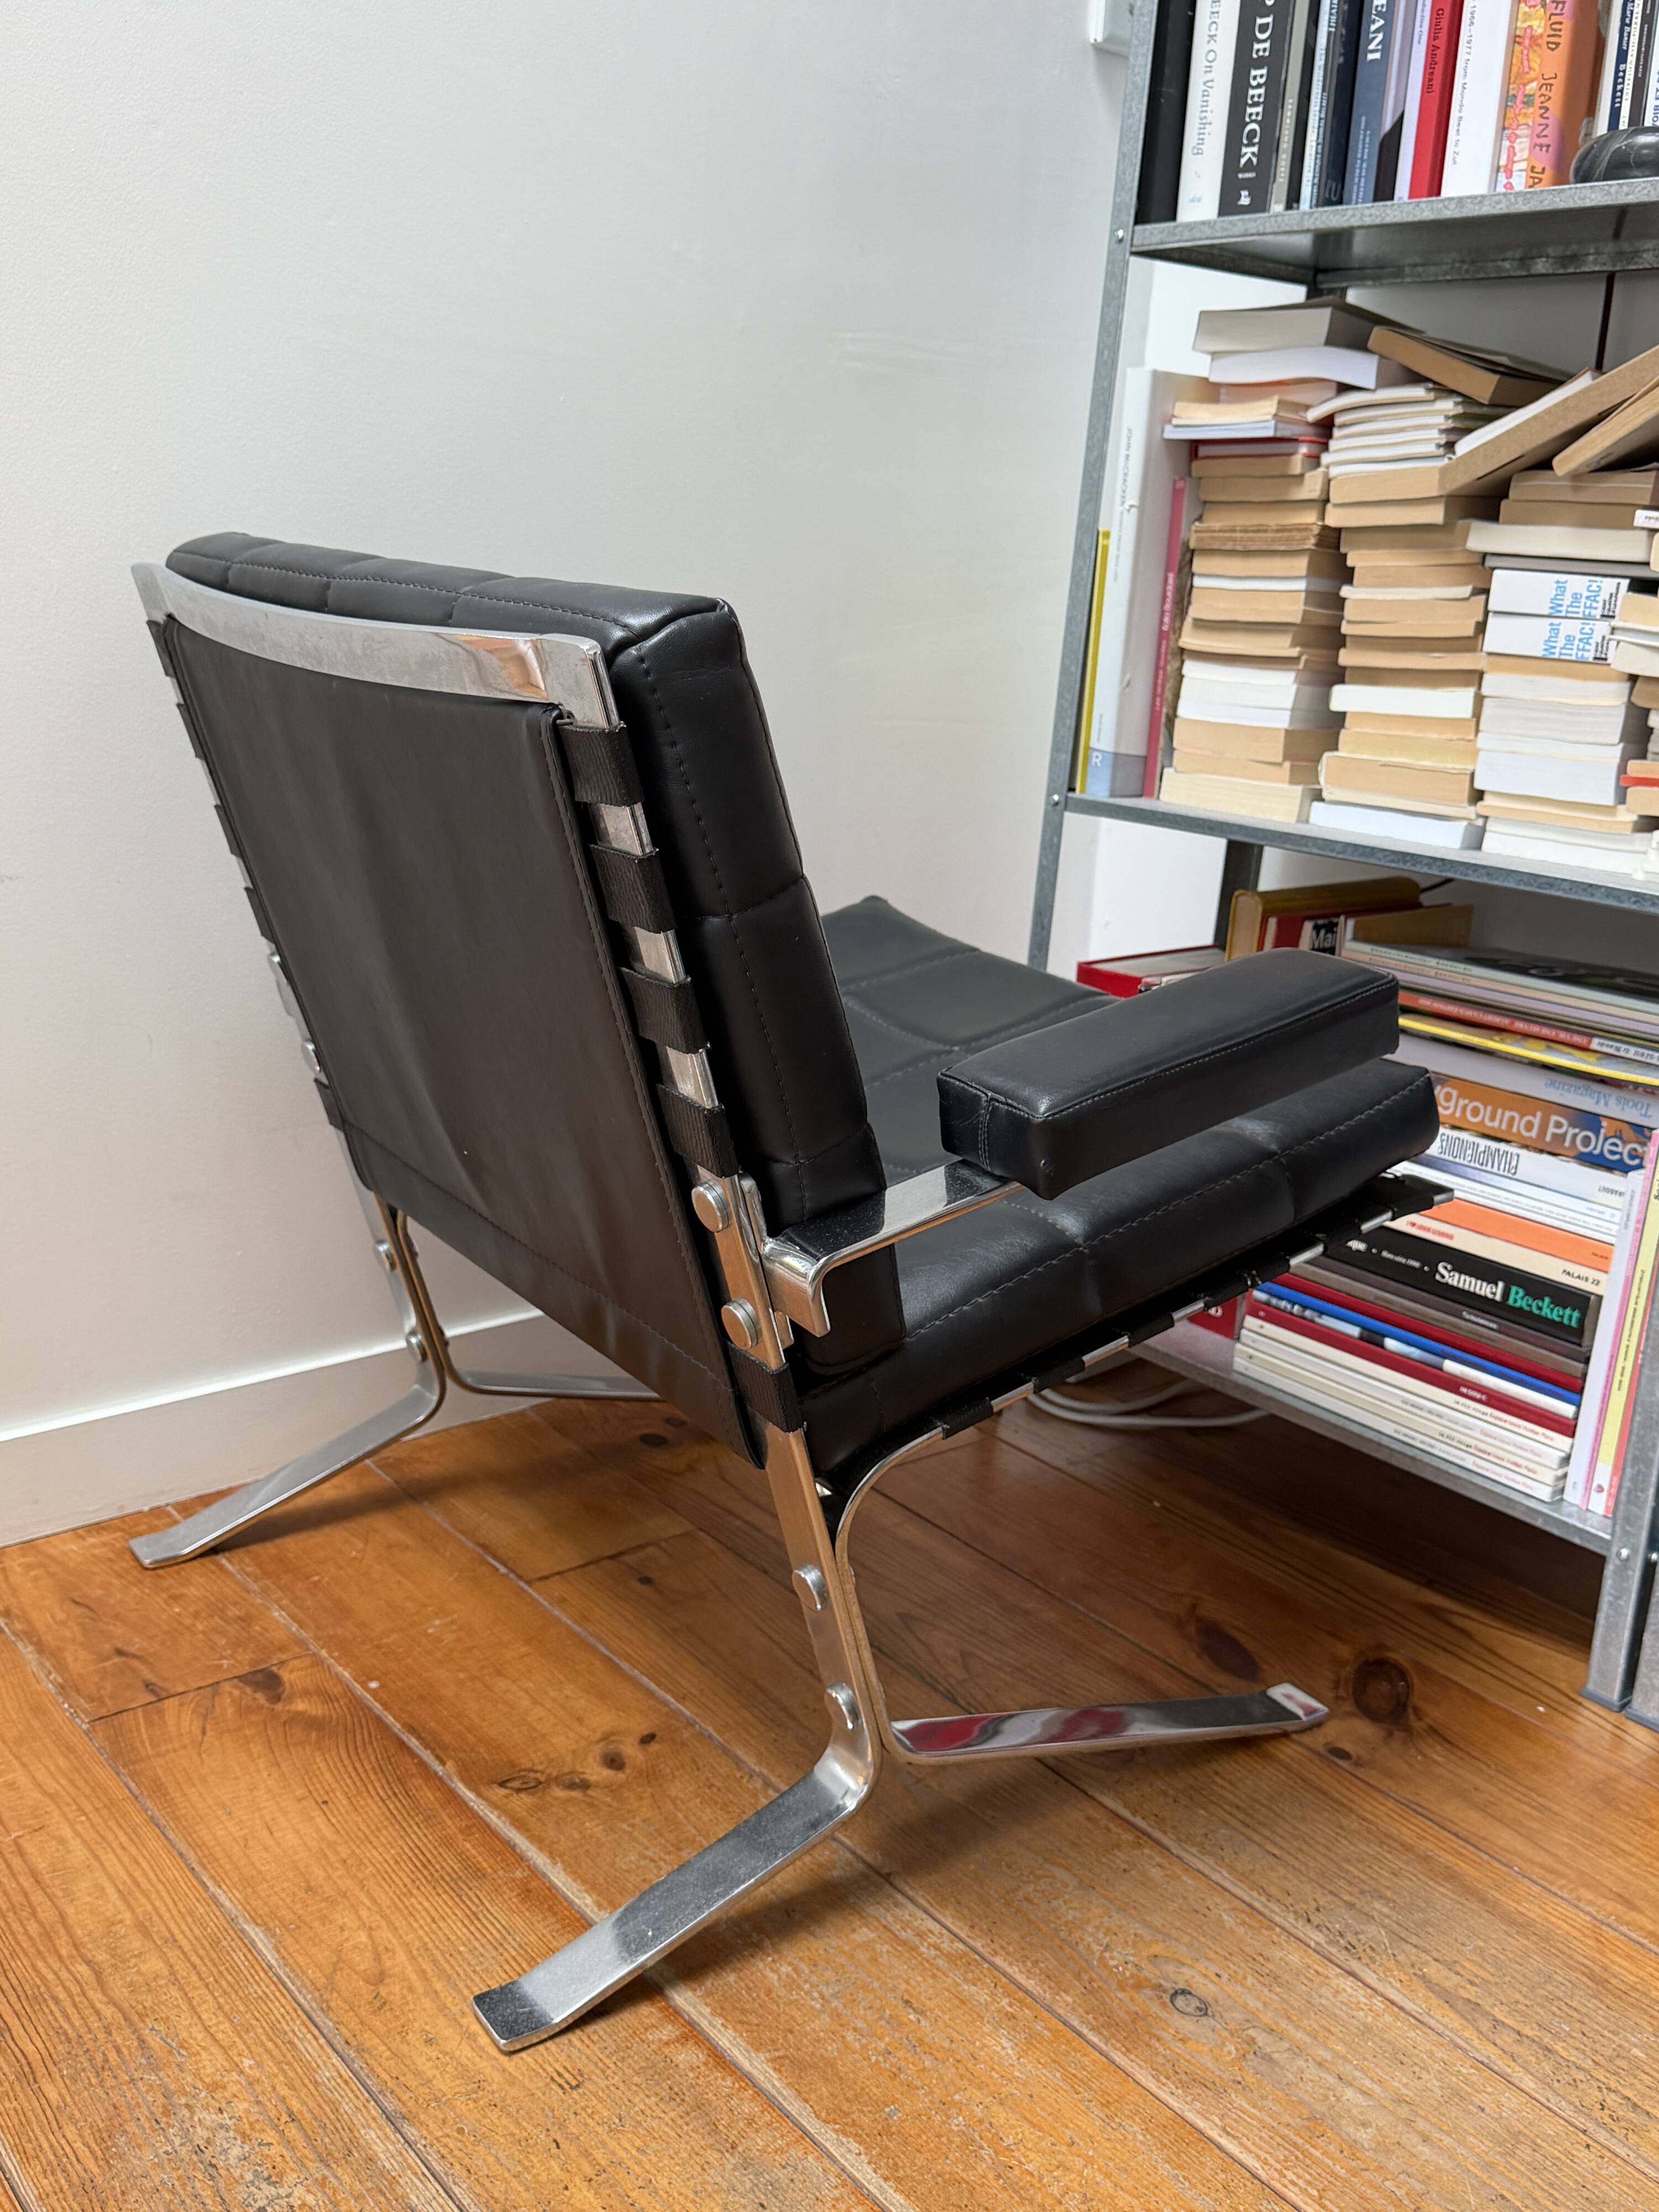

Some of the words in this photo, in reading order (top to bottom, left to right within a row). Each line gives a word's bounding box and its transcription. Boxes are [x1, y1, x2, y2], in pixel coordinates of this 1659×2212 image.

[1252, 14, 1274, 59] DE
[1433, 8, 1445, 41] Giulia
[1546, 1, 1567, 51] FLUID
[1204, 49, 1217, 74] On
[1426, 44, 1440, 93] Andreani
[1615, 64, 1626, 108] Beckett
[1191, 79, 1214, 155] Vanishing
[1239, 66, 1268, 168] BEECK
[1533, 72, 1557, 153] JEANNE
[1549, 580, 1568, 614] What
[1566, 593, 1582, 616] The
[1582, 580, 1603, 618] FFAC!
[1542, 622, 1561, 656] What
[1558, 634, 1575, 658] The
[1575, 622, 1595, 660] FFAC!
[1091, 753, 1102, 766] R
[1545, 1079, 1611, 1107] Magazine
[1615, 1094, 1652, 1118] Tools
[1438, 1133, 1520, 1176] CHAMPIGNONS
[1435, 1261, 1505, 1302] Samuel
[1506, 1284, 1581, 1328] Beckett
[1562, 1269, 1589, 1282] PALAIS
